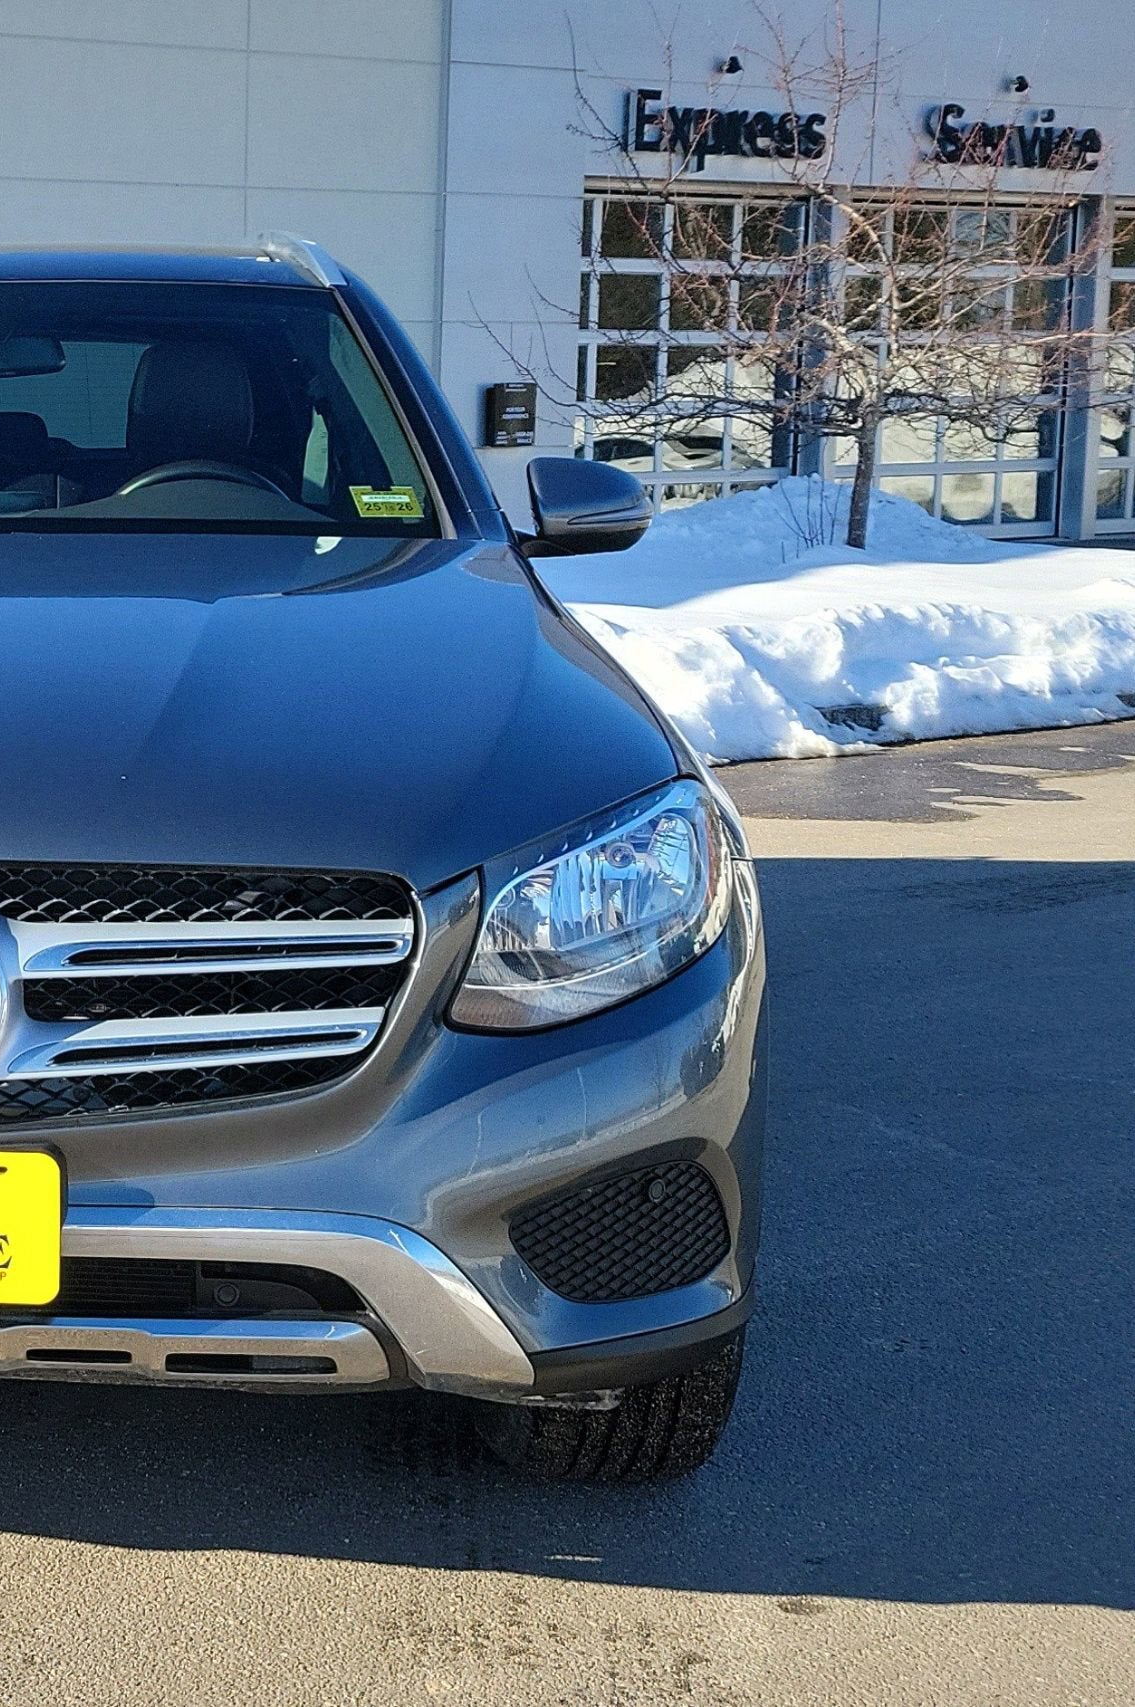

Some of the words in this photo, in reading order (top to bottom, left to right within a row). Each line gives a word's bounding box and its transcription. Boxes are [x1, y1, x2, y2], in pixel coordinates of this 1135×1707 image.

[635, 88, 828, 173] Express
[927, 102, 1102, 171] Service
[364, 502, 382, 511] 25
